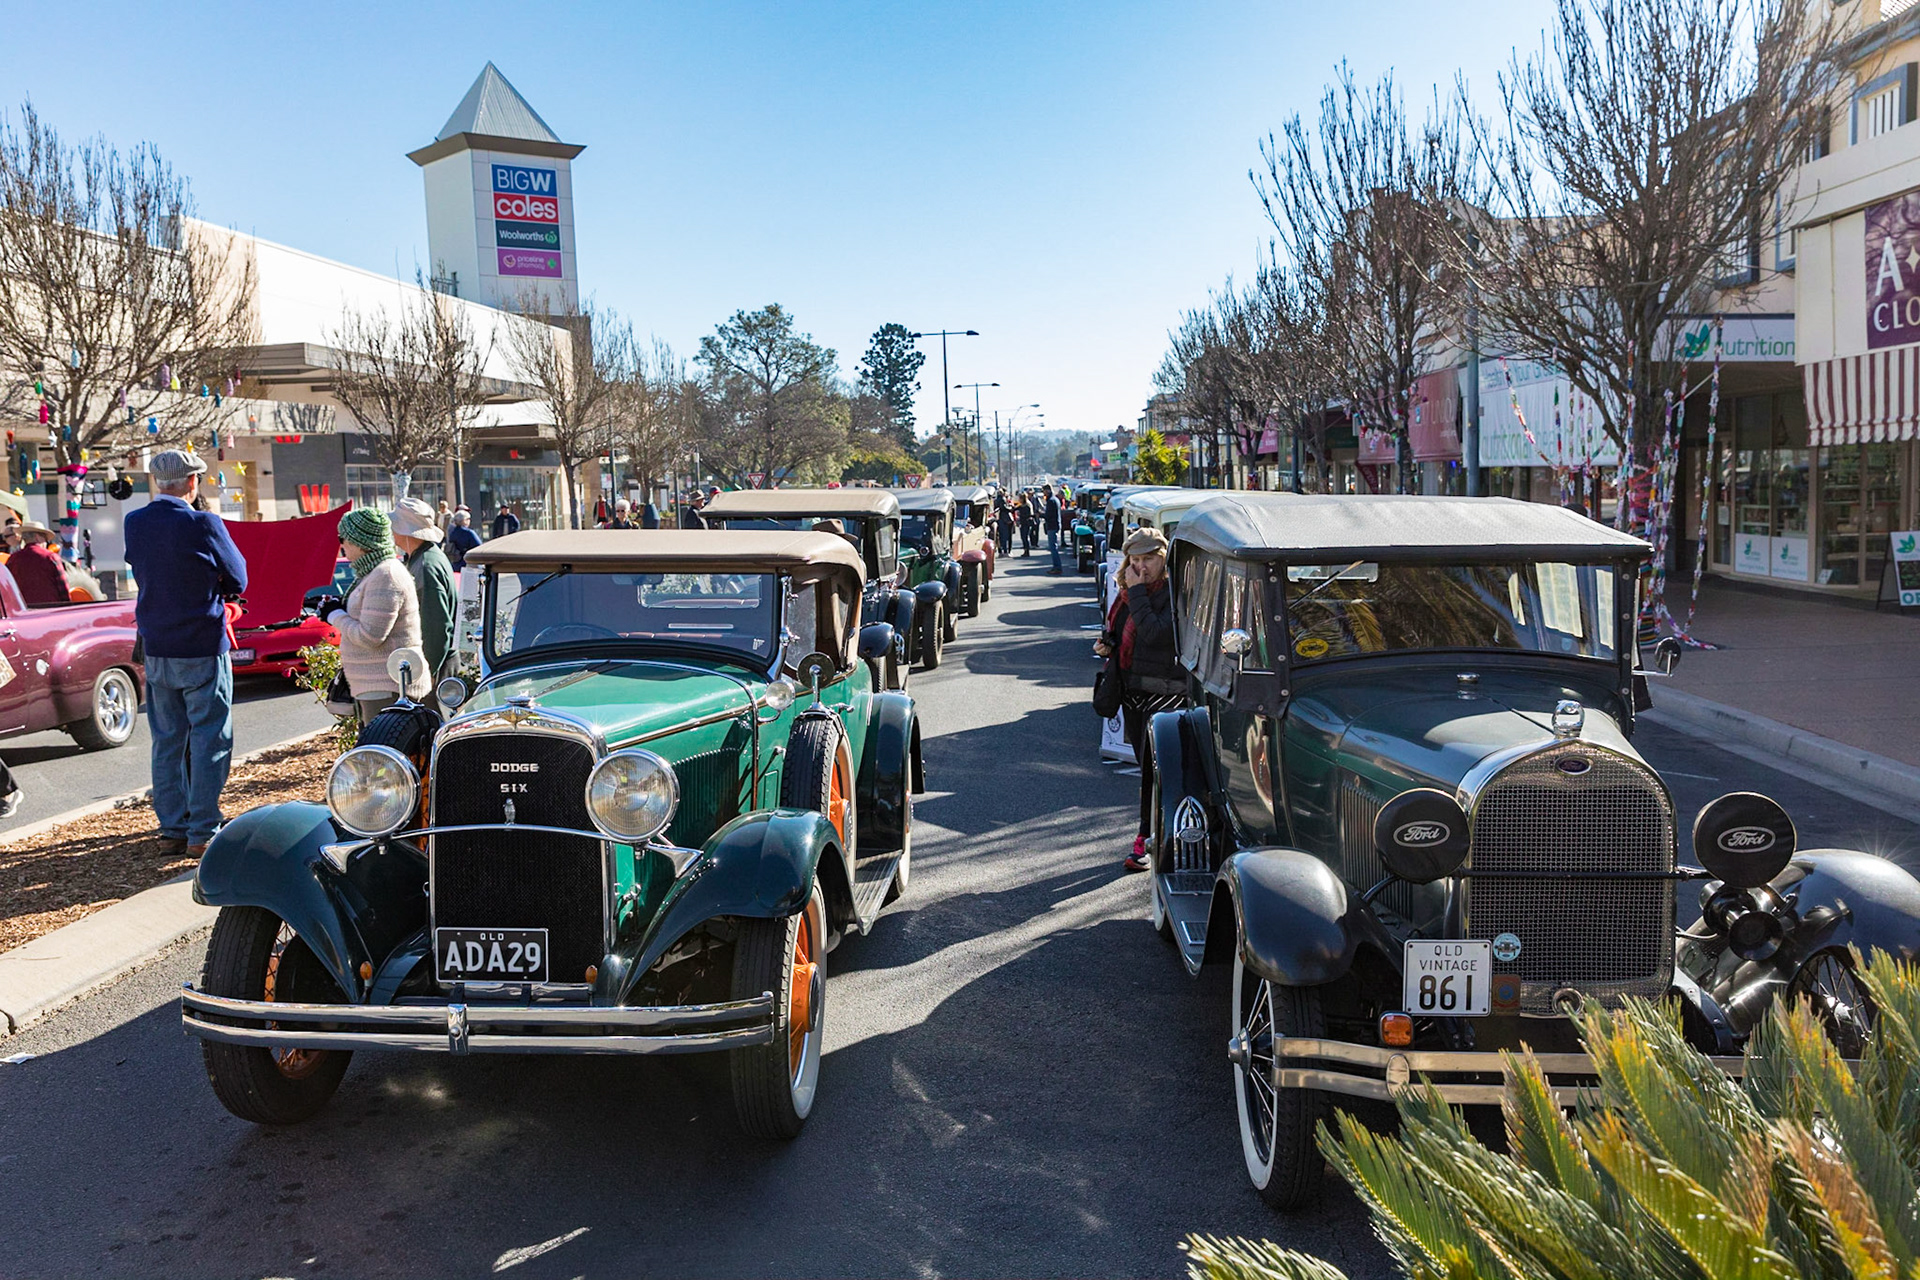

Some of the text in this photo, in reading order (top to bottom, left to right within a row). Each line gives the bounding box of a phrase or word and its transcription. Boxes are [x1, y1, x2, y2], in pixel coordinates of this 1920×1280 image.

[496, 194, 557, 219] coles
[499, 230, 545, 241] Woolworths
[490, 763, 539, 772] DODGE
[500, 783, 528, 793] SIX
[1403, 826, 1440, 842] Ford
[1728, 831, 1766, 847] Ford
[480, 932, 504, 941] QLD
[444, 941, 541, 972] ADA29
[1434, 945, 1463, 957] QLD
[1419, 960, 1478, 972] VINTAGE
[1419, 975, 1473, 1011] 861
